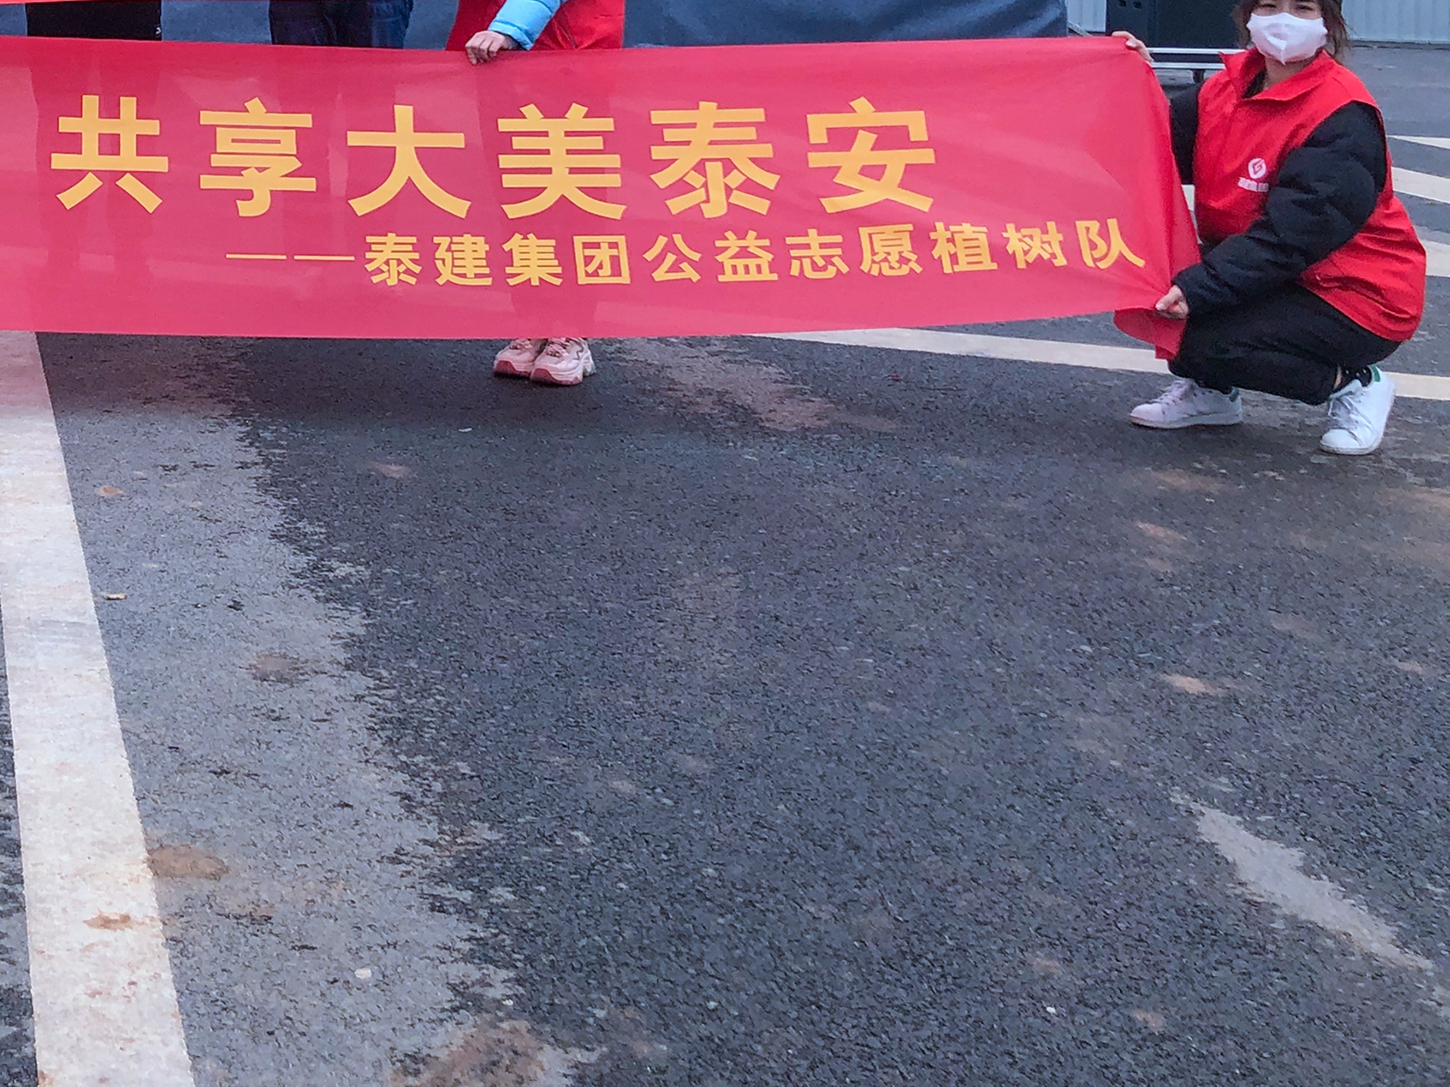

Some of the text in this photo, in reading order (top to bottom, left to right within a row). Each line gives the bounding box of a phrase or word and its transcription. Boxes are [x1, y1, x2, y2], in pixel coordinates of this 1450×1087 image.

[51, 96, 937, 218] 共享大美泰安
